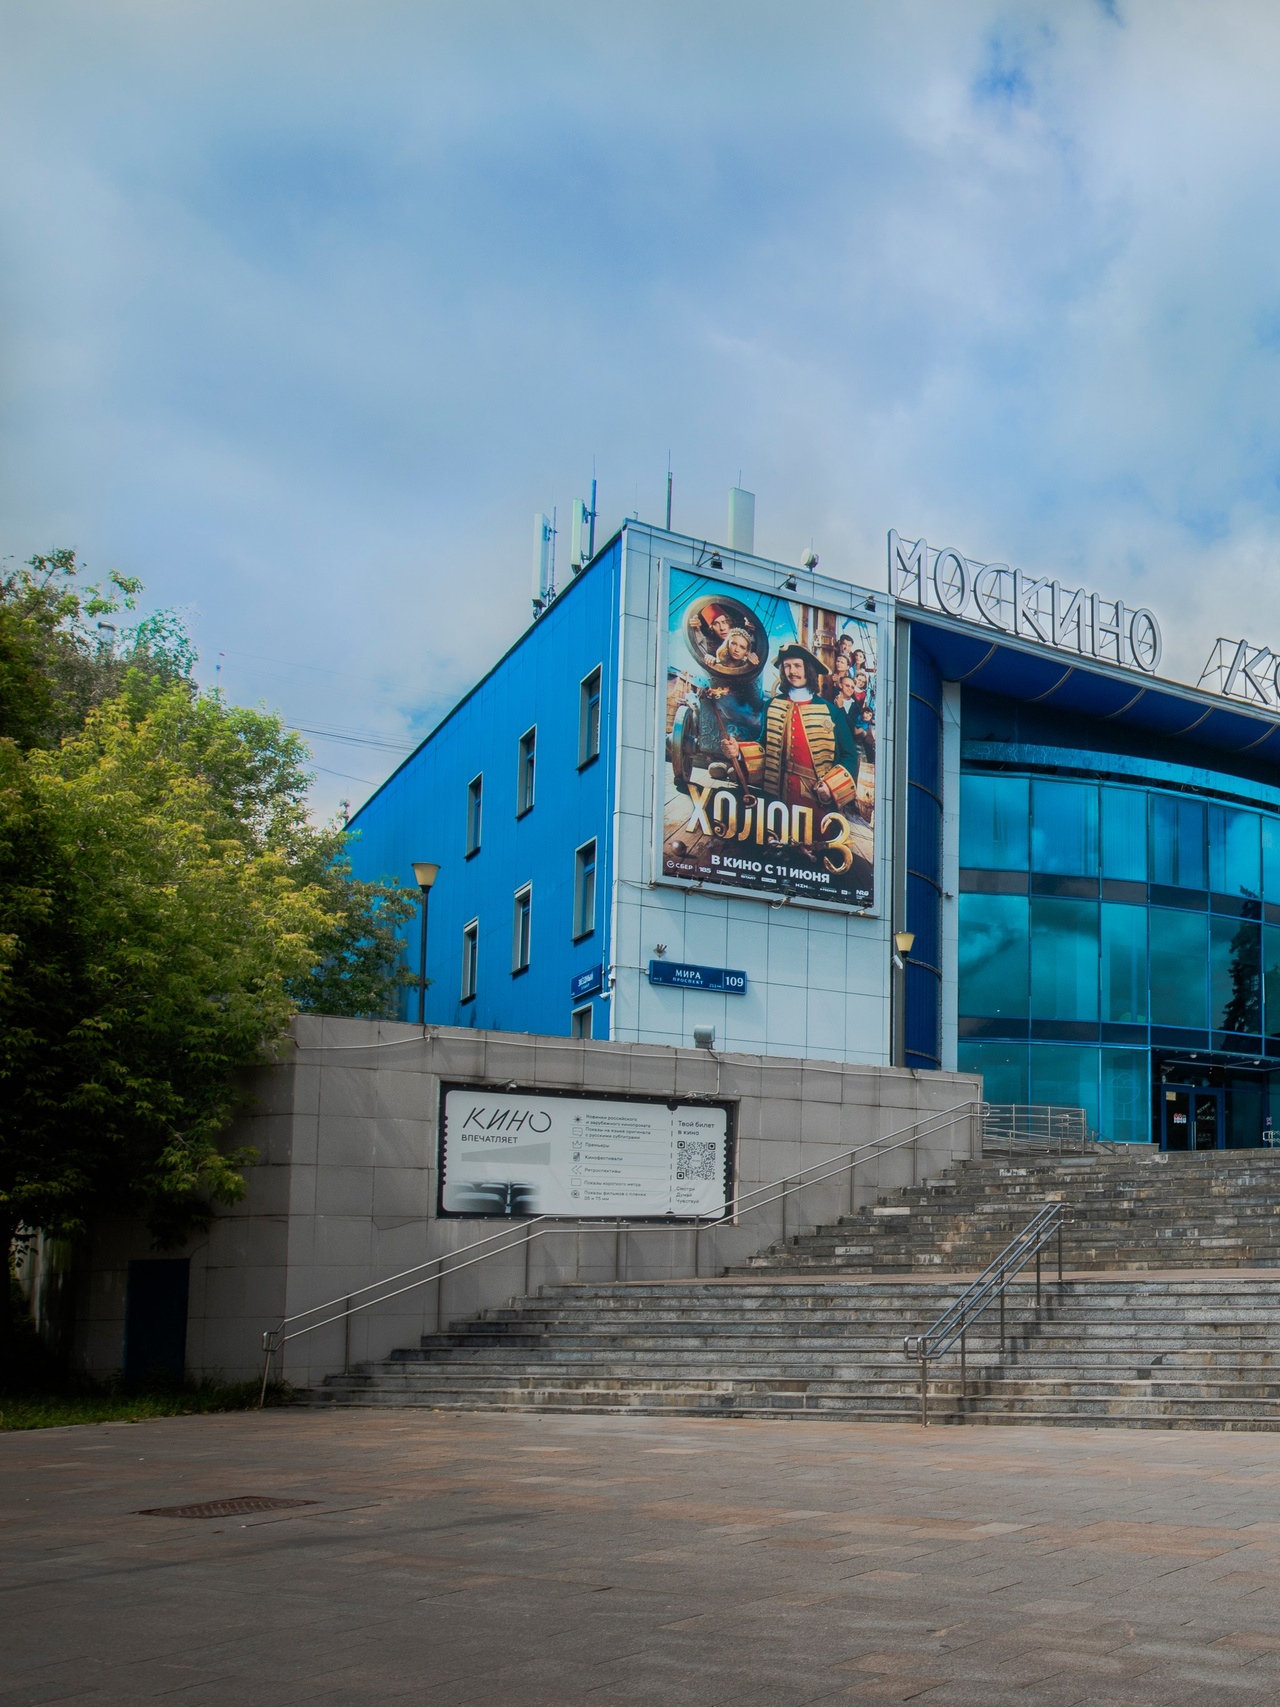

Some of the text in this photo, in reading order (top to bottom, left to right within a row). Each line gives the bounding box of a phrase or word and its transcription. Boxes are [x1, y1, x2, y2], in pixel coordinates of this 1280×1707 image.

[887, 528, 1162, 672] МОСКИНО
[685, 783, 854, 875] ХОЛОП 3
[675, 862, 694, 870] СБЕР
[711, 854, 721, 865] В
[723, 856, 762, 872] КИНО
[764, 863, 774, 874] С
[776, 865, 788, 877] 11
[789, 867, 830, 884] ИЮНЯ
[672, 976, 704, 985] ПРОСПЕКТ
[675, 969, 701, 980] МИРА
[725, 976, 744, 987] 109
[462, 1107, 552, 1133] КИНО
[678, 1120, 715, 1129] Твой билет
[461, 1133, 518, 1144] ВПЕЧАТЛЯЕТ
